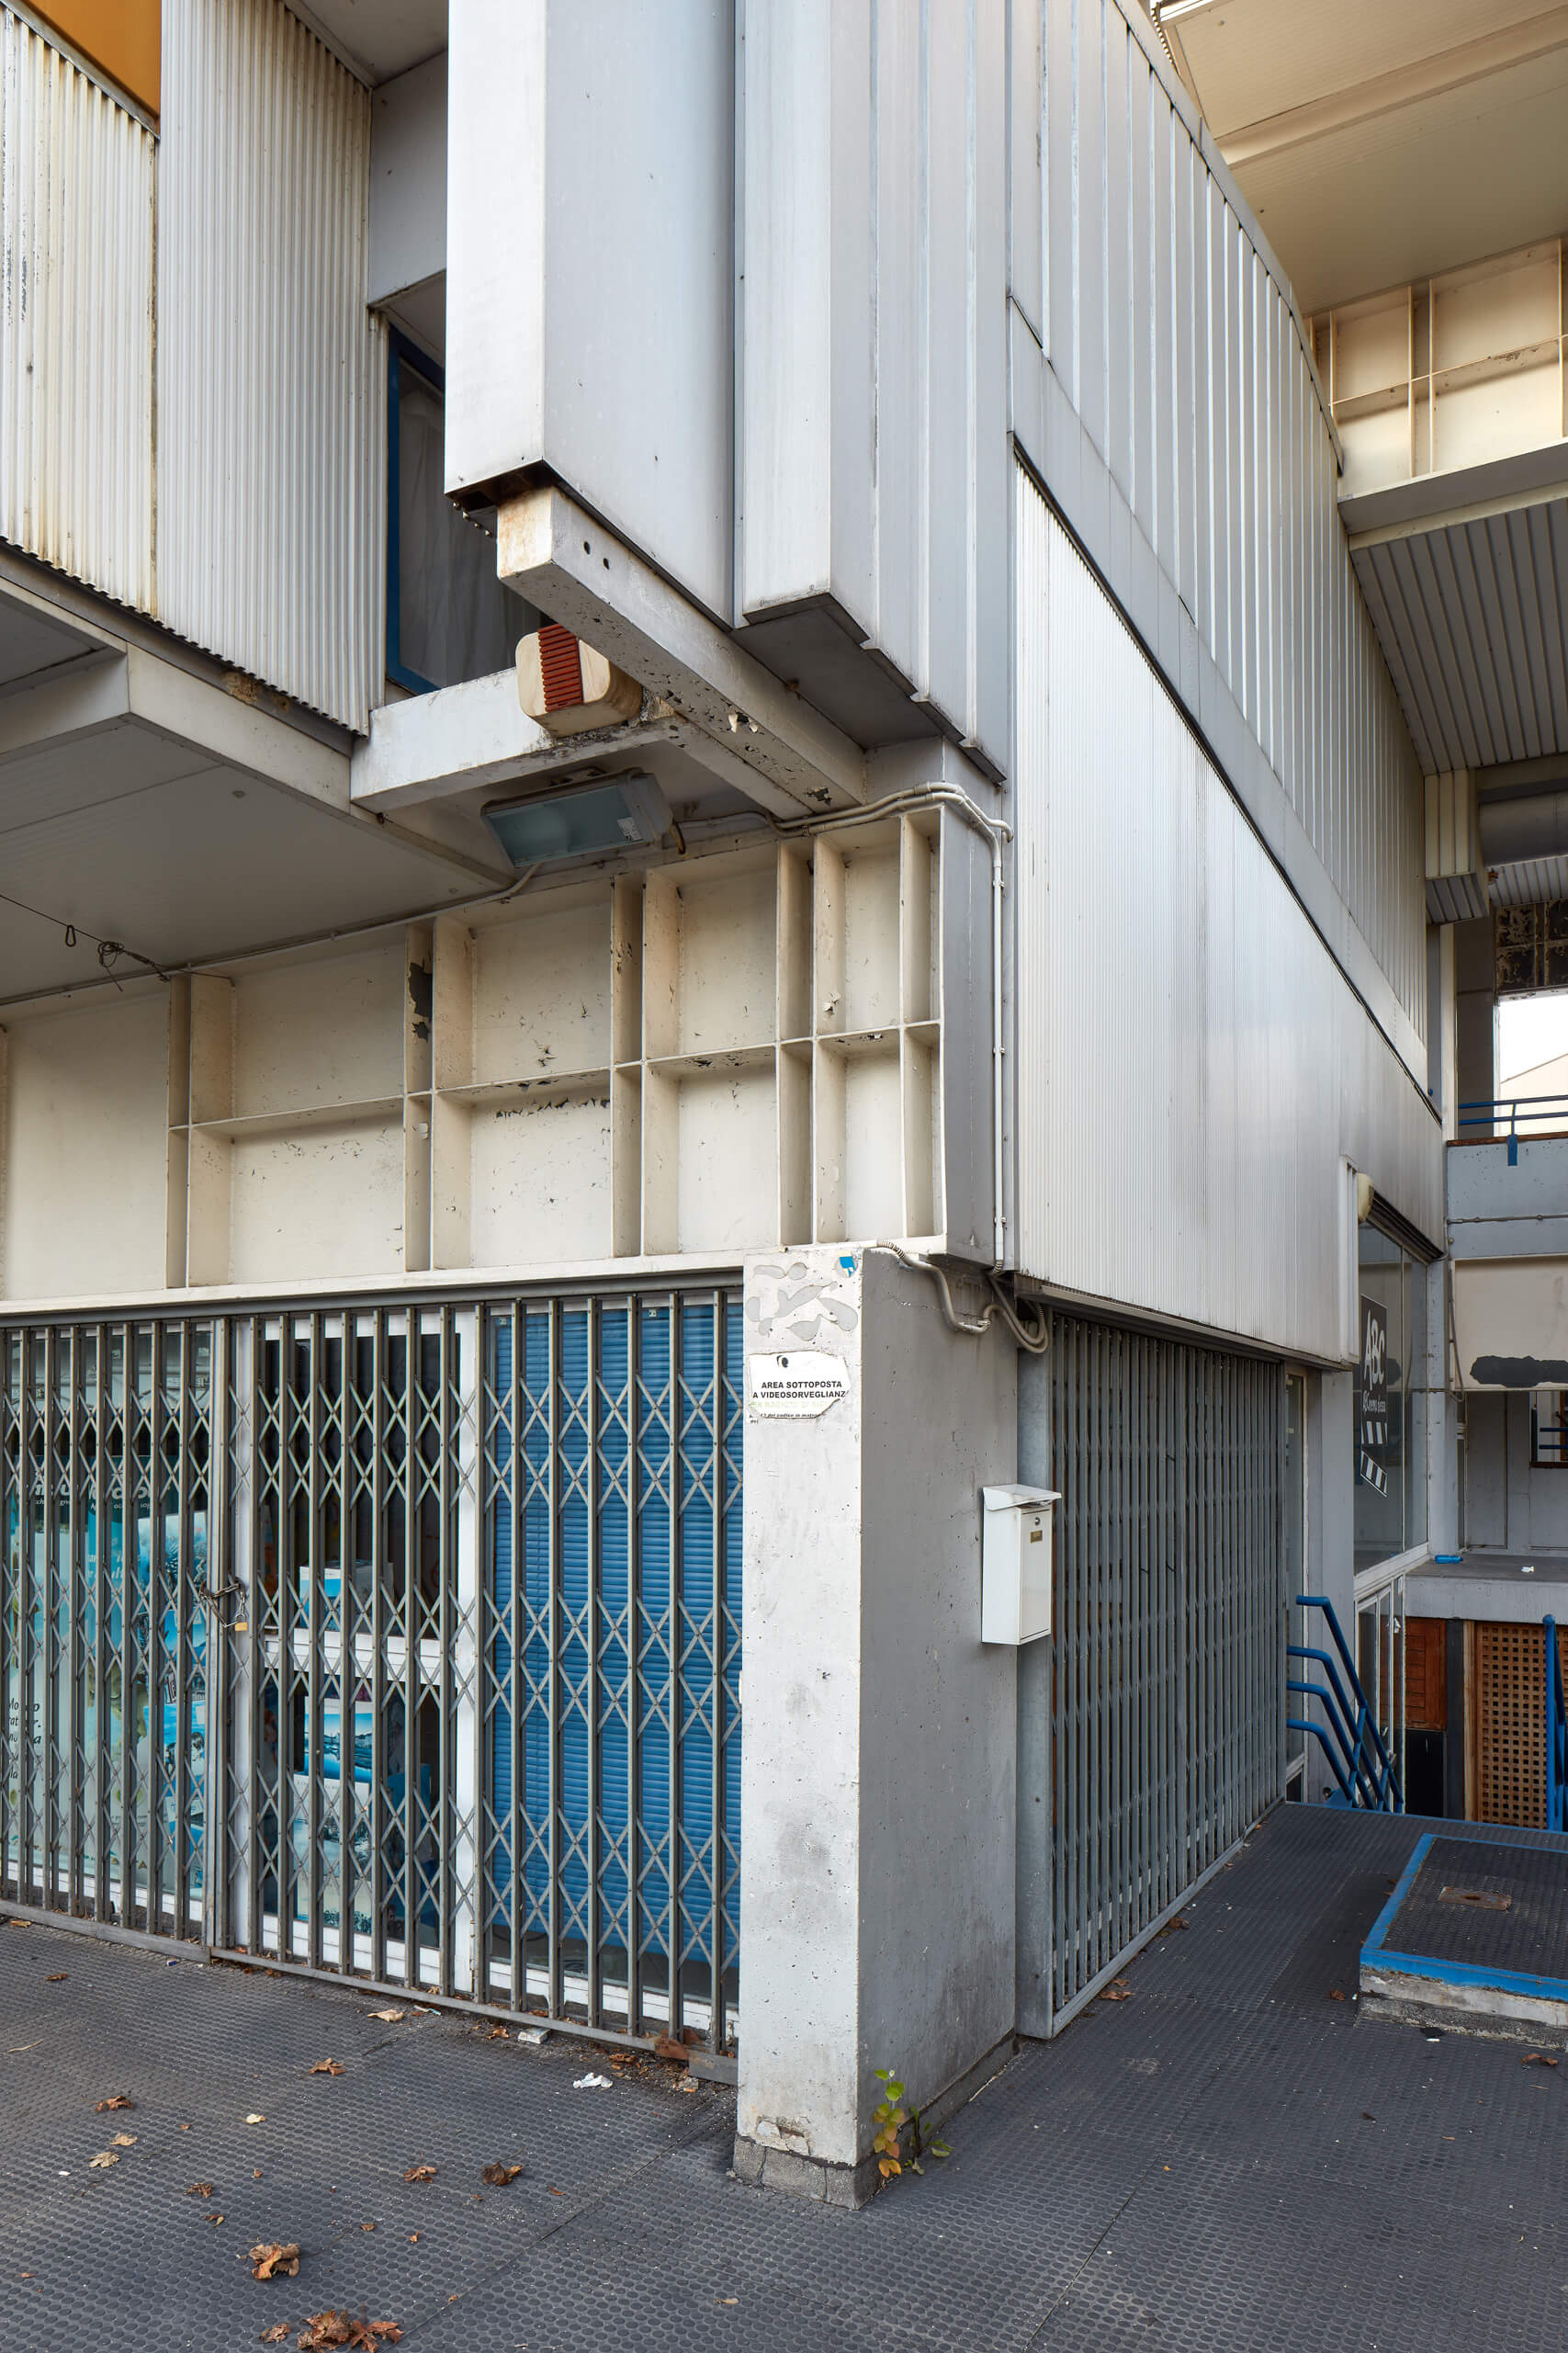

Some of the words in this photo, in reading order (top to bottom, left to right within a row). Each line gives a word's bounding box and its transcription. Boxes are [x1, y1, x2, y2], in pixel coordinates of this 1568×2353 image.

[1364, 1309, 1385, 1391] ABC
[785, 1380, 842, 1388] SOTTOPOSTA
[761, 1390, 849, 1398] VIDEOSORVEGLIANZ
